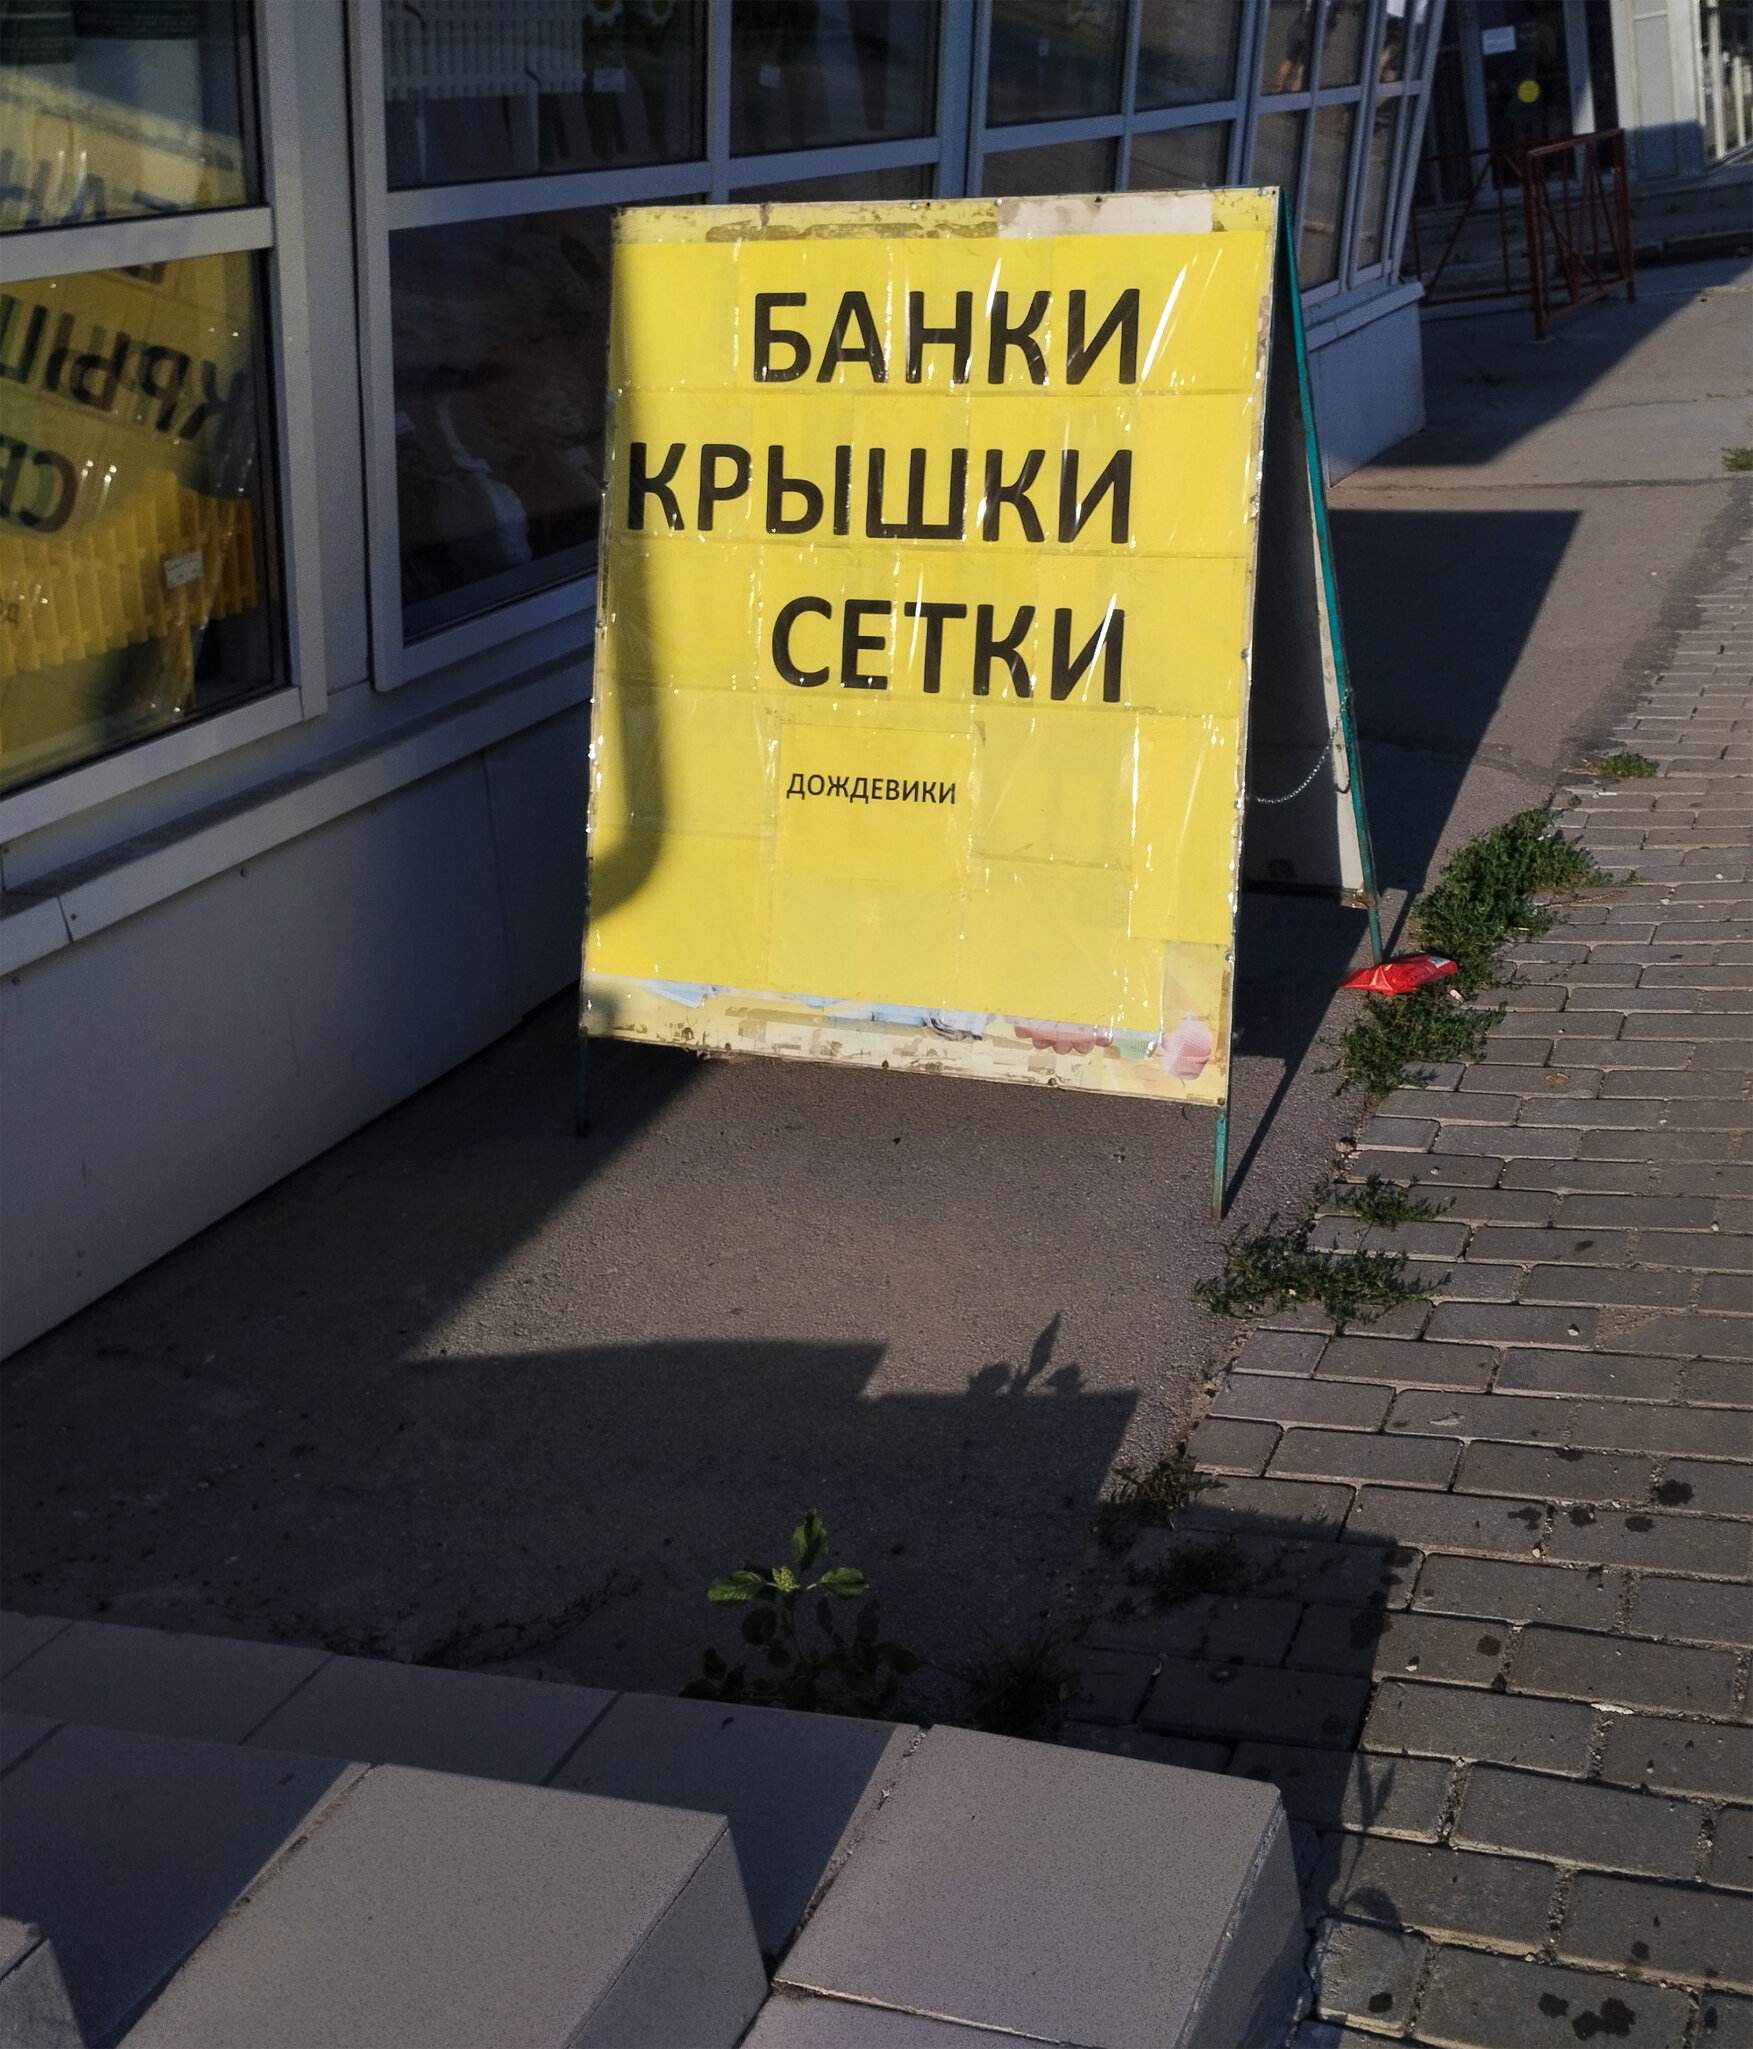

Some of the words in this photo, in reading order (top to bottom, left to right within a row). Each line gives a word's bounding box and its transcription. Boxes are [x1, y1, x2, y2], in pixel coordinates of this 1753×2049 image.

[753, 289, 1140, 385] БАНКИ
[624, 441, 1132, 544] КРЫШКИ
[772, 596, 1125, 703] СЕТКИ
[786, 773, 957, 805] ДОЖДЕВИКИ
